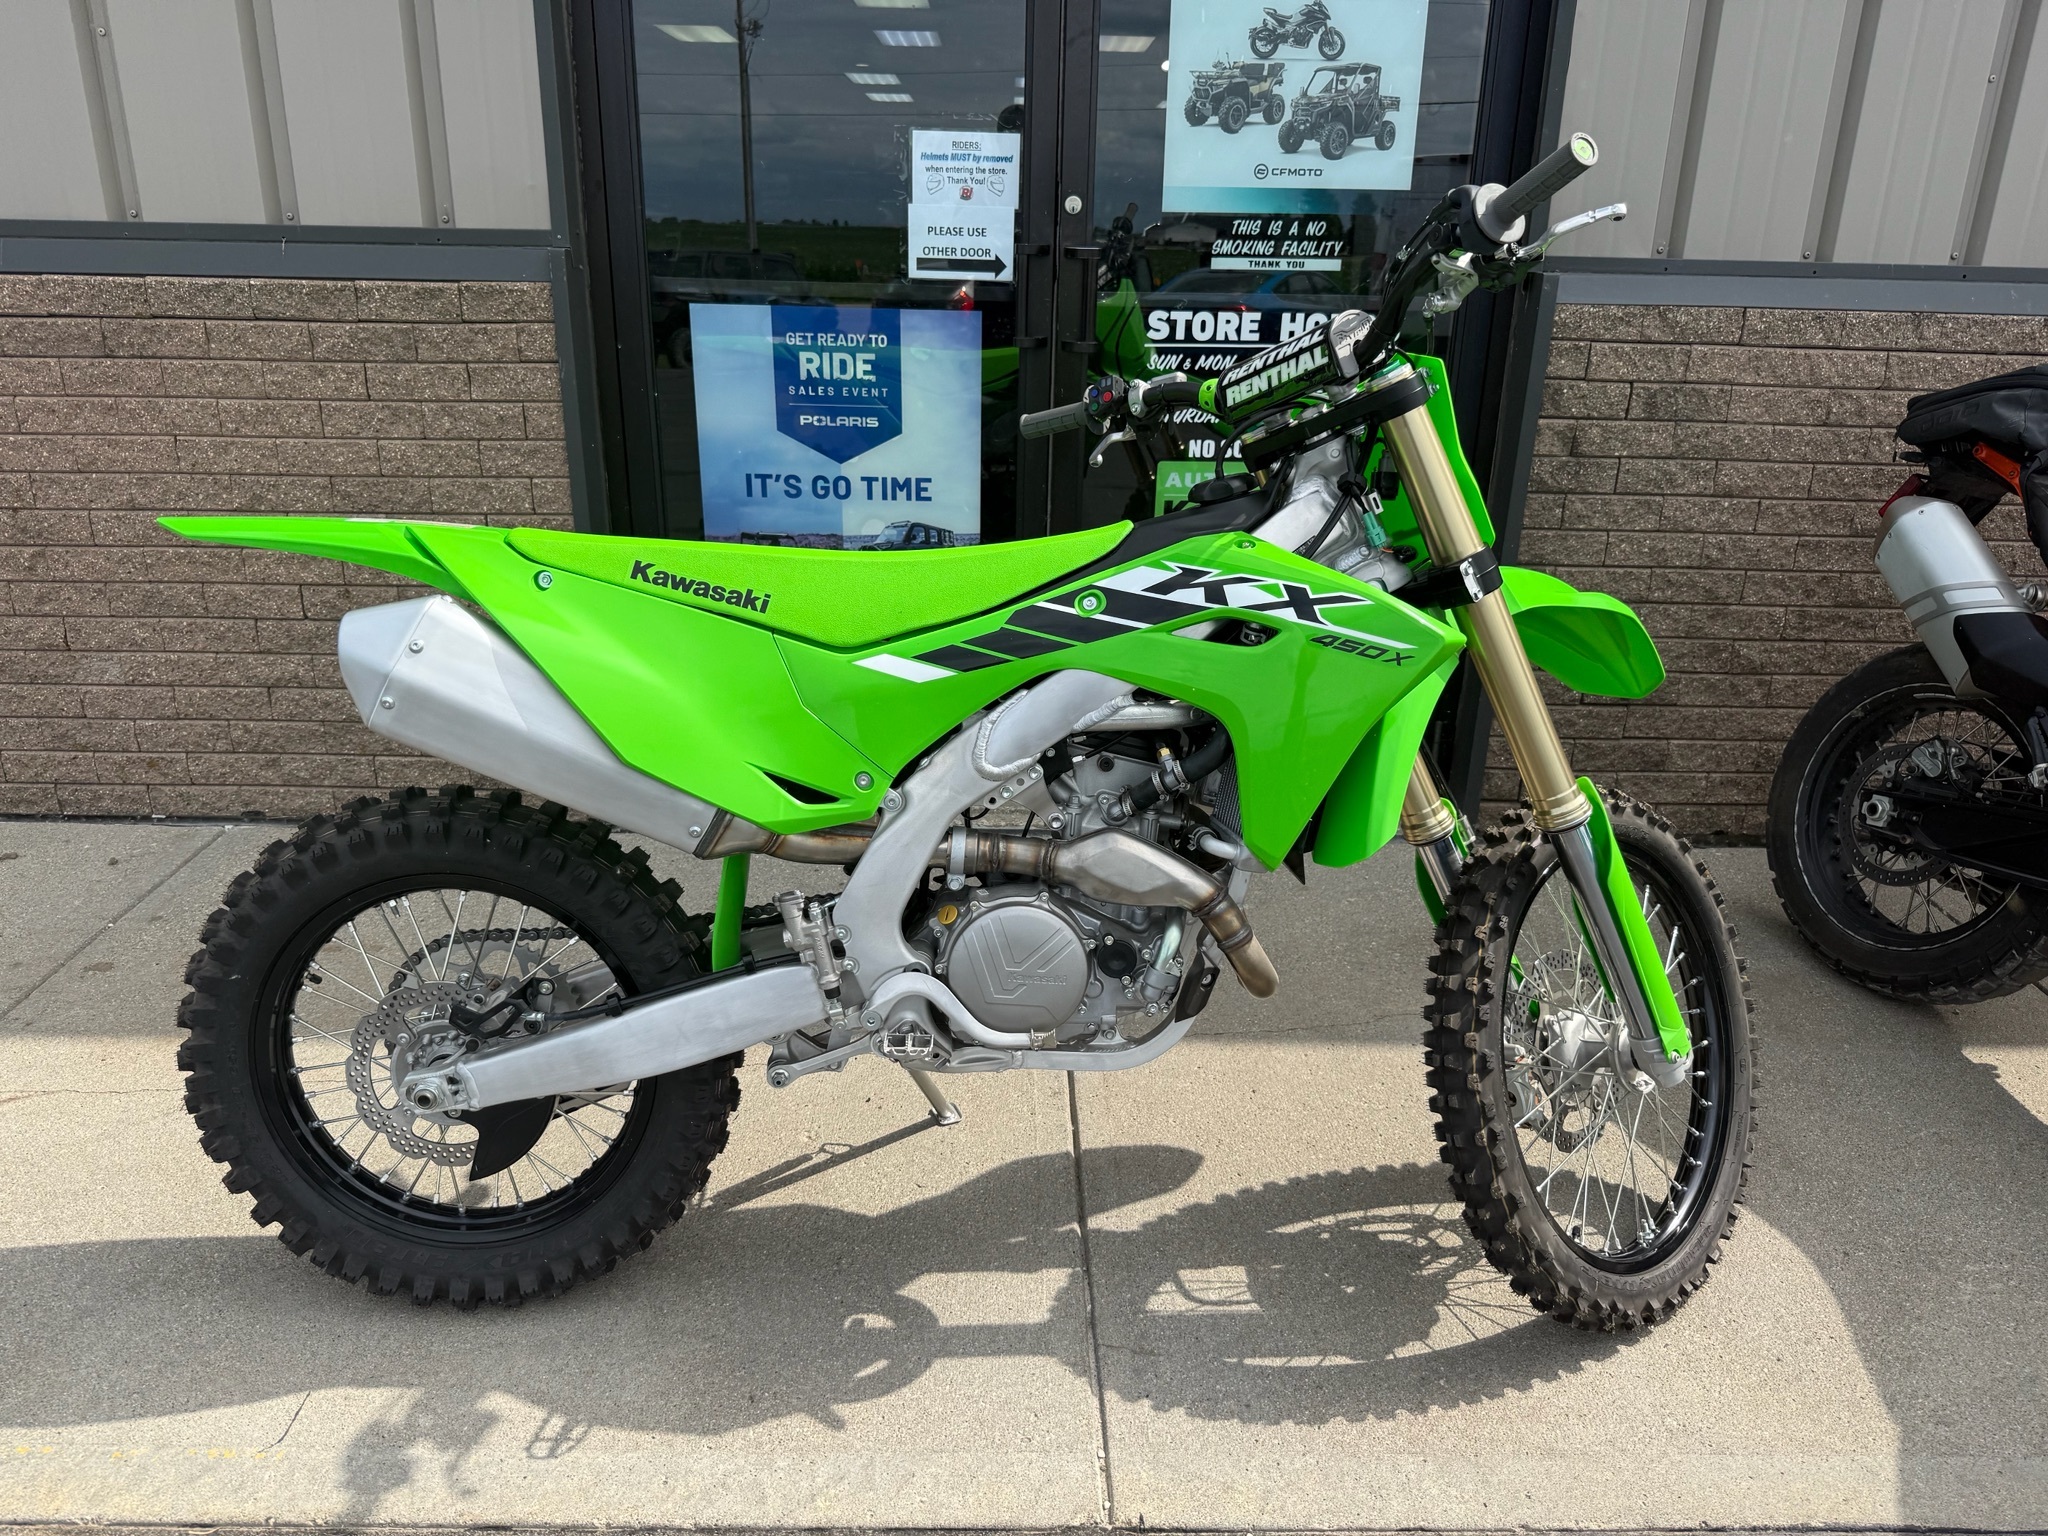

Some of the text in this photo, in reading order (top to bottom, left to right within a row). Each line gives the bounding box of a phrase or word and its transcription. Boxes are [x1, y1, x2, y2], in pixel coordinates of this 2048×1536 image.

[952, 141, 981, 150] RIDERS:
[921, 152, 1014, 164] Helmets MUST by removed
[925, 165, 944, 173] when
[945, 166, 973, 175] entering
[987, 167, 1008, 175] store.
[1271, 168, 1323, 177] CFMOTO
[947, 176, 986, 185] Thank You!
[927, 226, 987, 237] PLEASE USE
[1231, 219, 1327, 237] THIS IS A NO
[922, 246, 991, 258] OTHER DOOR
[1211, 239, 1343, 257] SMOKING FACILITY
[1248, 260, 1305, 269] THANK YOU
[1146, 310, 1261, 342] STORE
[786, 332, 888, 348] GET READY TO
[1147, 354, 1238, 371] SUN & MON
[1222, 328, 1326, 386] RENTHAL
[799, 351, 876, 382] RIDE
[1225, 344, 1329, 408] RENTHAL
[788, 386, 889, 397] SALES EVENT
[800, 415, 879, 428] POLARIS
[1188, 439, 1216, 458] NO
[745, 473, 932, 502] IT'S GO TIME
[630, 559, 772, 614] Kawasaki
[1139, 564, 1371, 626] KX
[1007, 972, 1067, 986] Kawasaki
